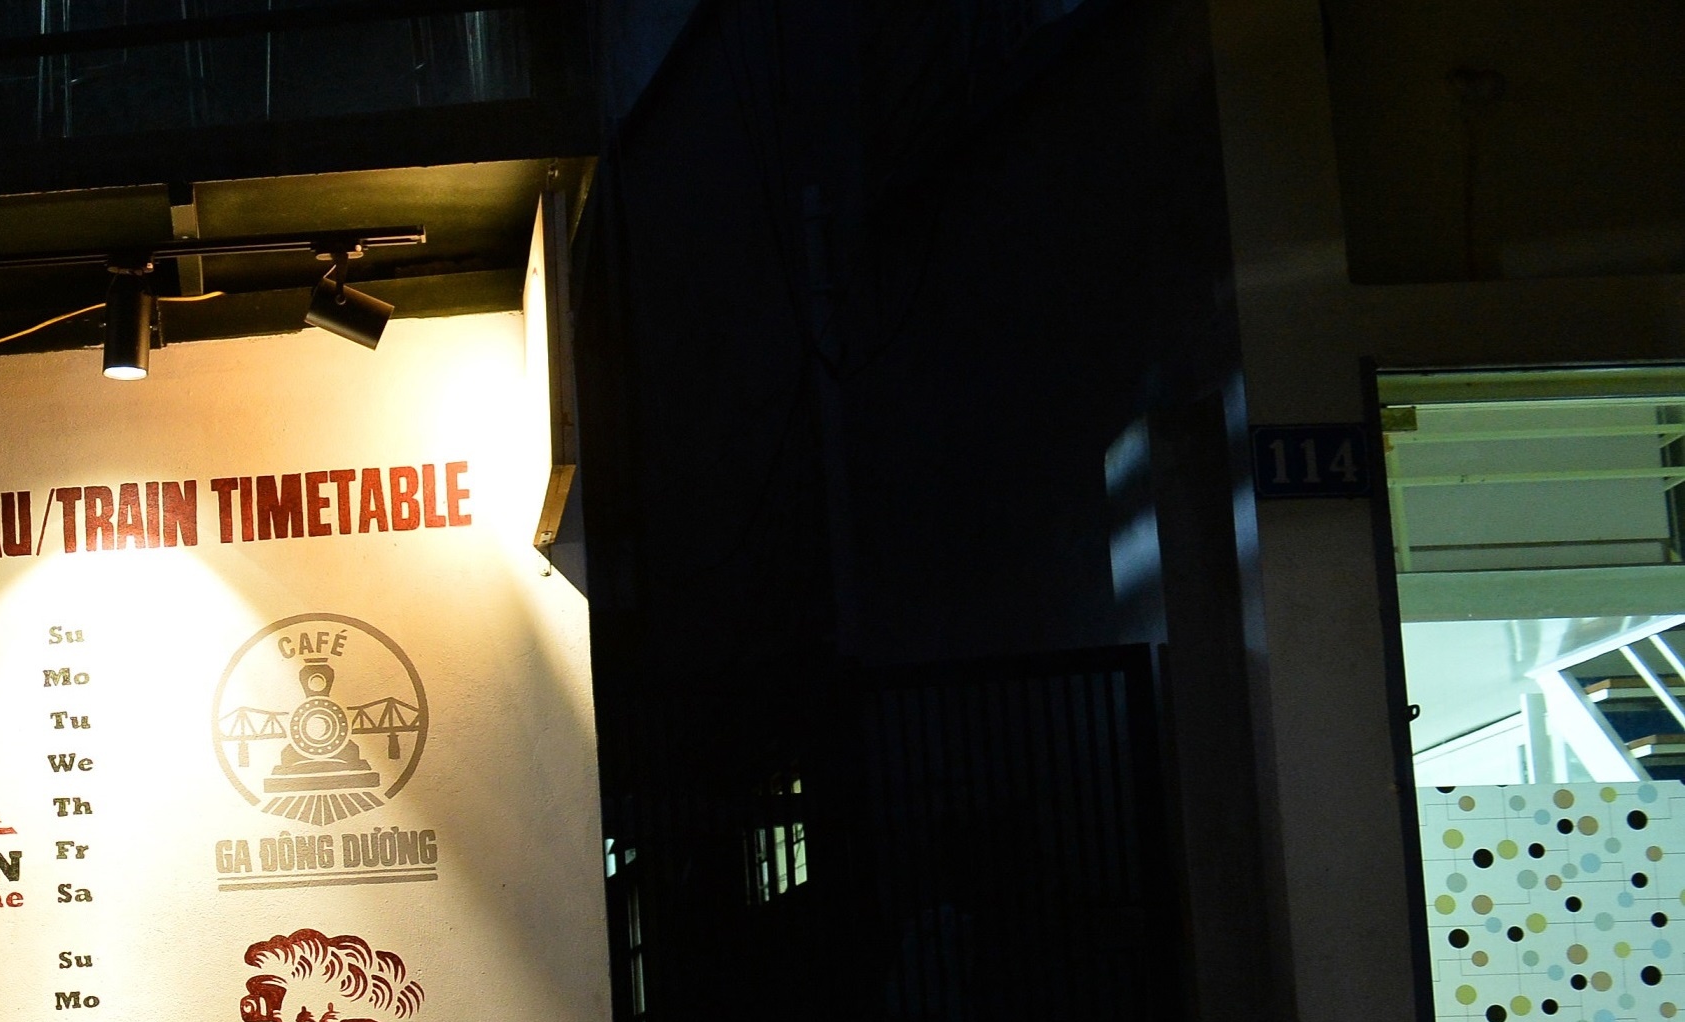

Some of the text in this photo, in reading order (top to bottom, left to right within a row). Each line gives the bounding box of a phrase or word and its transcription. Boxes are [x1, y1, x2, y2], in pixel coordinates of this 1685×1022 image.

[1268, 438, 1359, 484] 114
[210, 461, 472, 544] TIMETABLE
[48, 625, 84, 645] Su
[278, 629, 348, 659] CAFÉ
[43, 667, 90, 688] Mo
[50, 711, 91, 730] Tu
[47, 753, 94, 773] We
[53, 797, 93, 817] Th
[55, 840, 89, 860] Fr
[215, 840, 252, 874] GA
[259, 830, 334, 873] ĐÔNG
[57, 883, 93, 904] Sa
[58, 951, 93, 969] Su
[54, 991, 100, 1010] Mo
